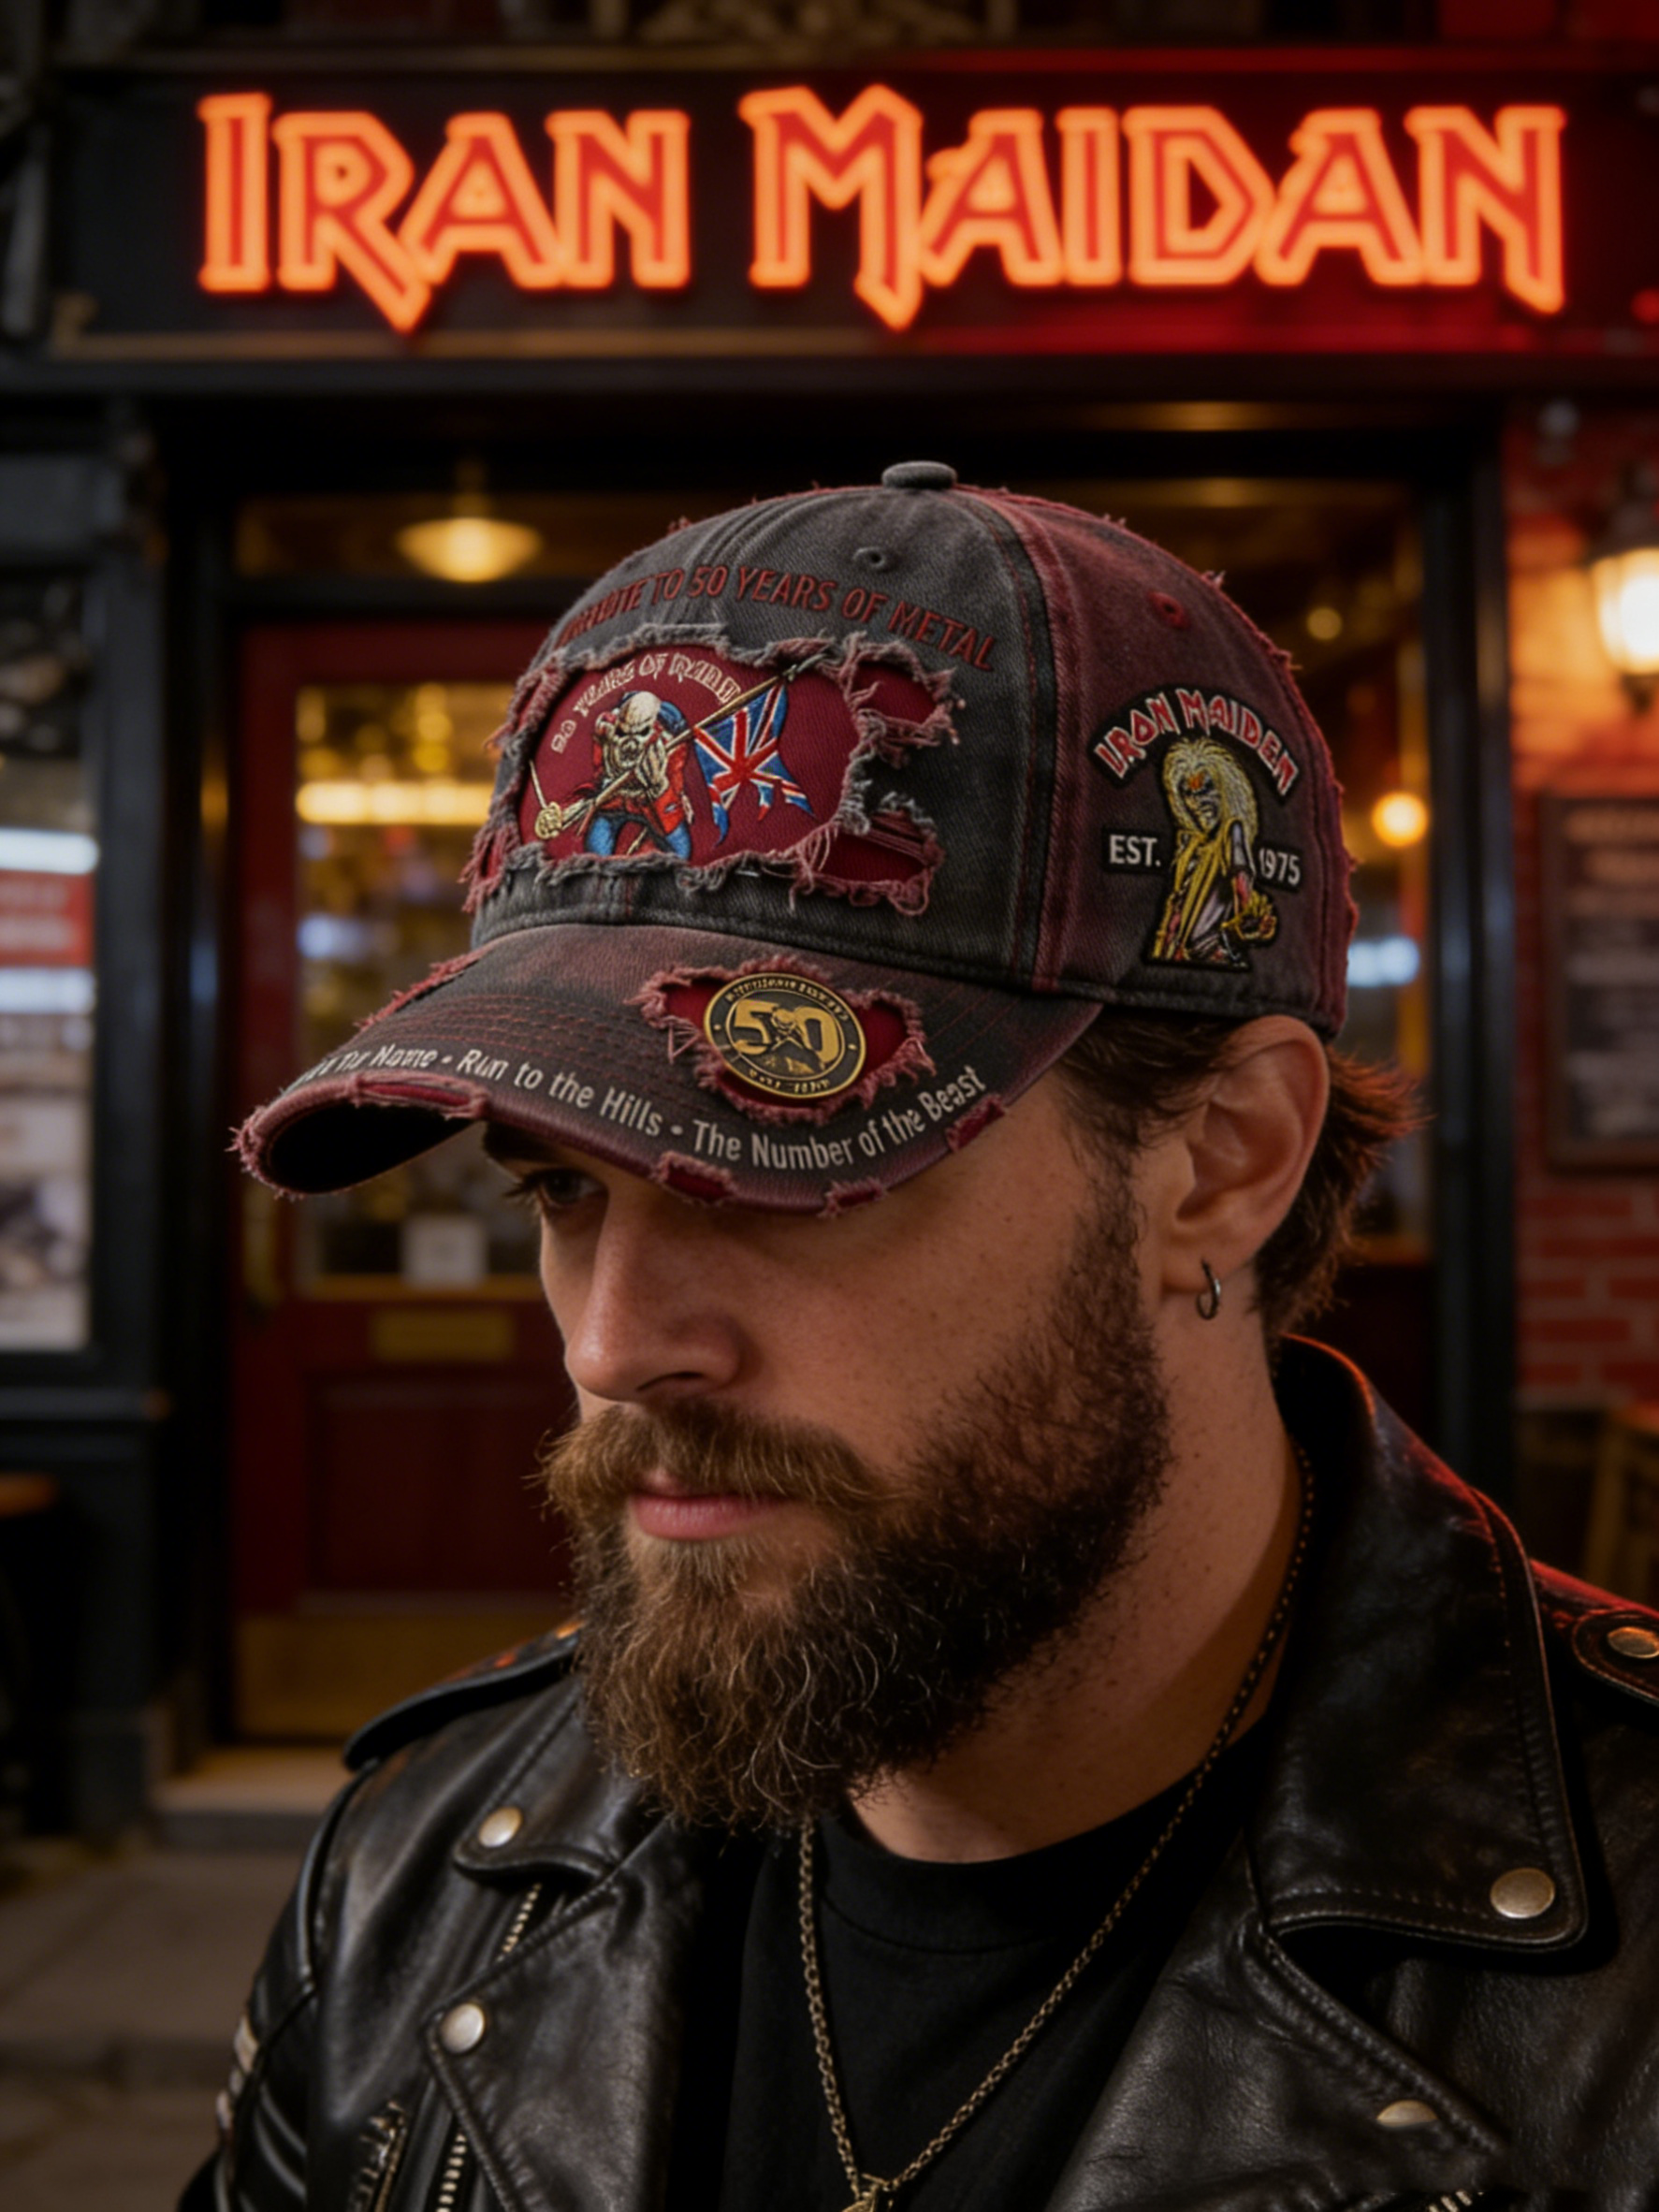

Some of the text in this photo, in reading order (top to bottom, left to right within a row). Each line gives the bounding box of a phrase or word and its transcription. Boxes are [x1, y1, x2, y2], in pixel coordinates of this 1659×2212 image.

[197, 84, 1566, 331] IRAN MAIDAN
[651, 568, 685, 605] TO
[687, 565, 727, 597] 50
[735, 565, 837, 612] YEARS
[842, 588, 889, 624] OF
[887, 600, 994, 672] METAL
[1094, 688, 1300, 796] IRON MAIDEN
[1108, 834, 1302, 886] EST. 1975
[734, 998, 840, 1064] 50
[456, 1049, 509, 1082] Run
[514, 1062, 544, 1090] to
[548, 1071, 597, 1110] the
[599, 1085, 663, 1138] Hills
[692, 1119, 742, 1162] The
[751, 1132, 853, 1171] Number
[858, 1119, 885, 1157] of
[881, 1109, 926, 1145] the
[917, 1065, 987, 1122] Beast
